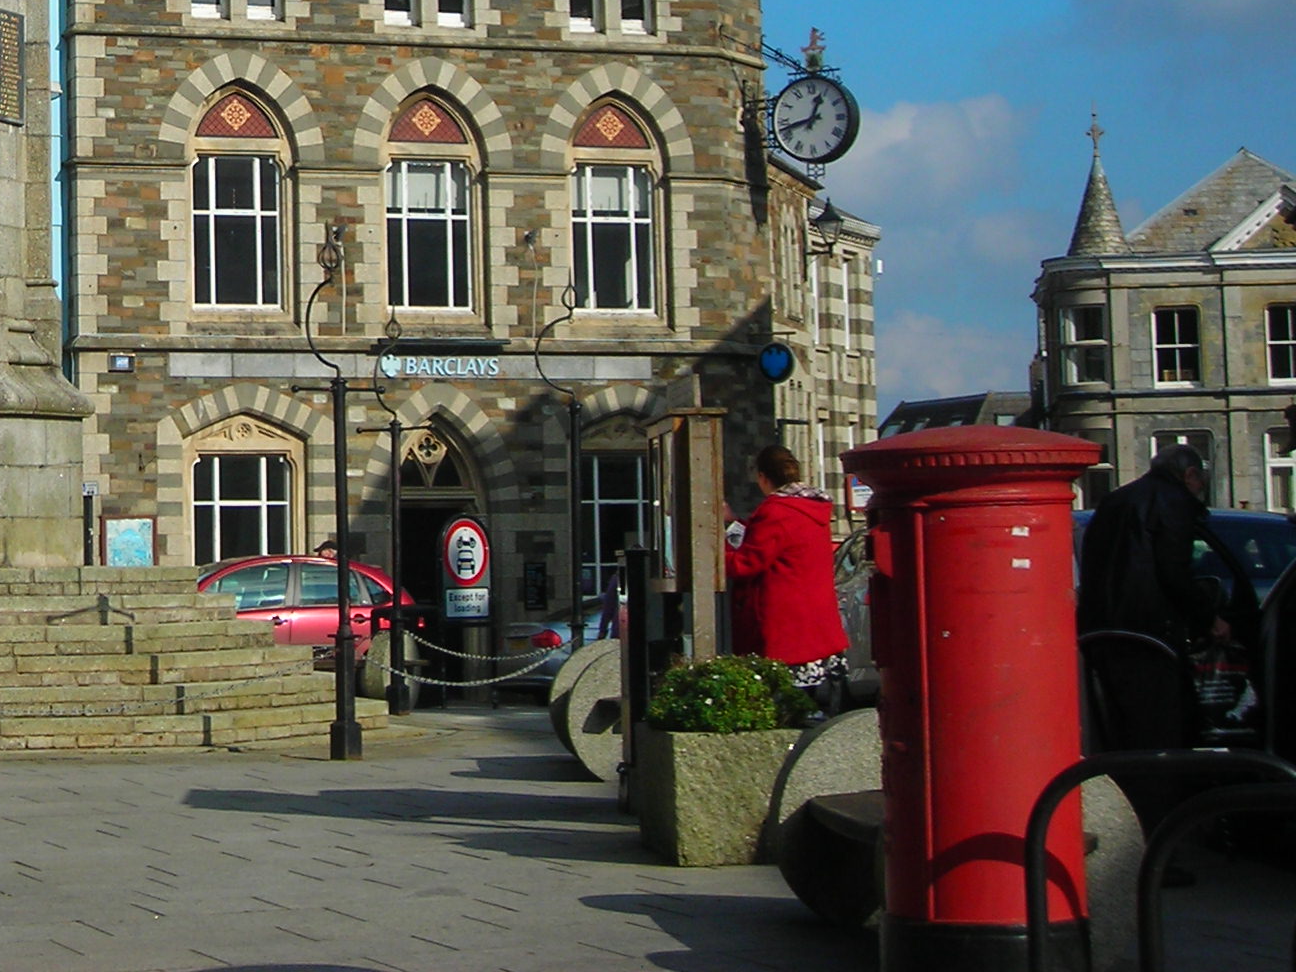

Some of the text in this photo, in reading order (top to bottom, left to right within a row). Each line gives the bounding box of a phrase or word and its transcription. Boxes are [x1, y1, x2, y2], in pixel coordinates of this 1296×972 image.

[405, 357, 500, 376] BARCLAYS
[449, 593, 486, 603] Except for
[454, 604, 481, 614] loading
